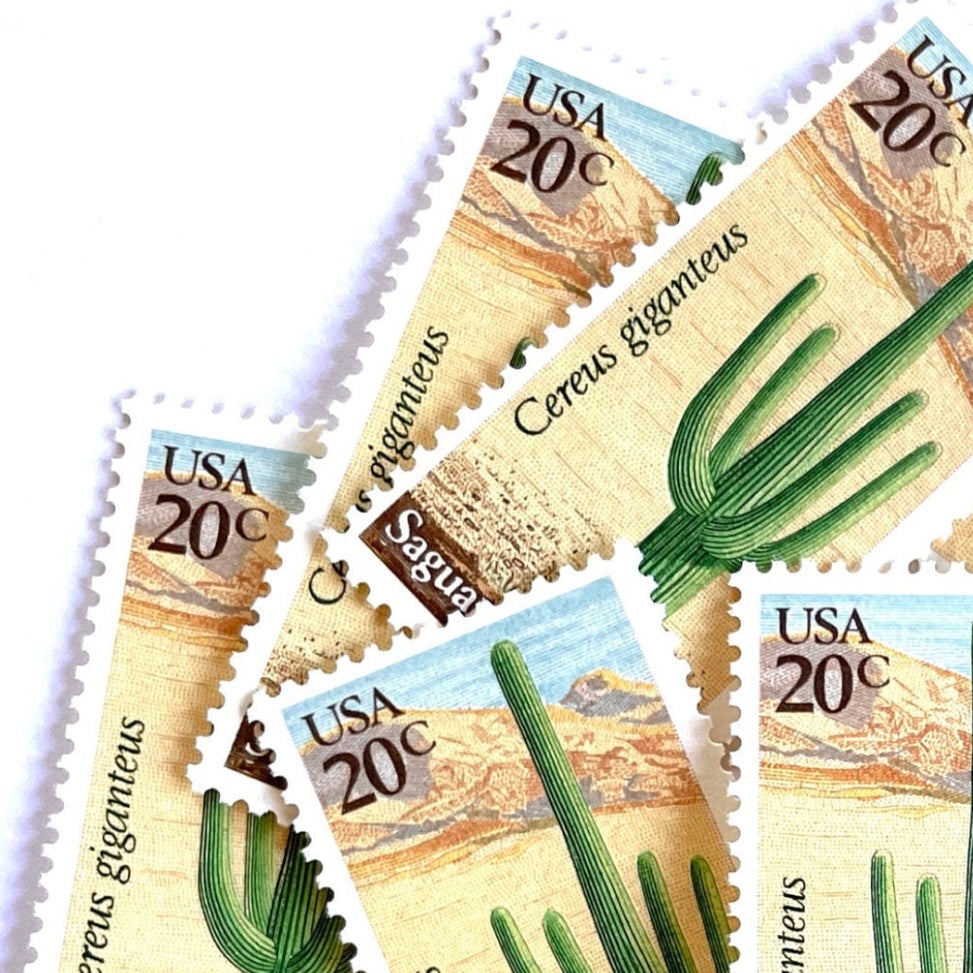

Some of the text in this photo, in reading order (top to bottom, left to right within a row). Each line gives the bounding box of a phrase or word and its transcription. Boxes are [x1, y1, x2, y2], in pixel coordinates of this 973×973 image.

[523, 74, 608, 141] USA
[513, 221, 748, 436] Cereus giganteus
[370, 326, 449, 486] giganteus
[164, 446, 256, 495] USA
[385, 508, 478, 614] Sagua
[775, 608, 873, 644] USA
[302, 687, 405, 746] USA
[89, 716, 144, 884] giganteus
